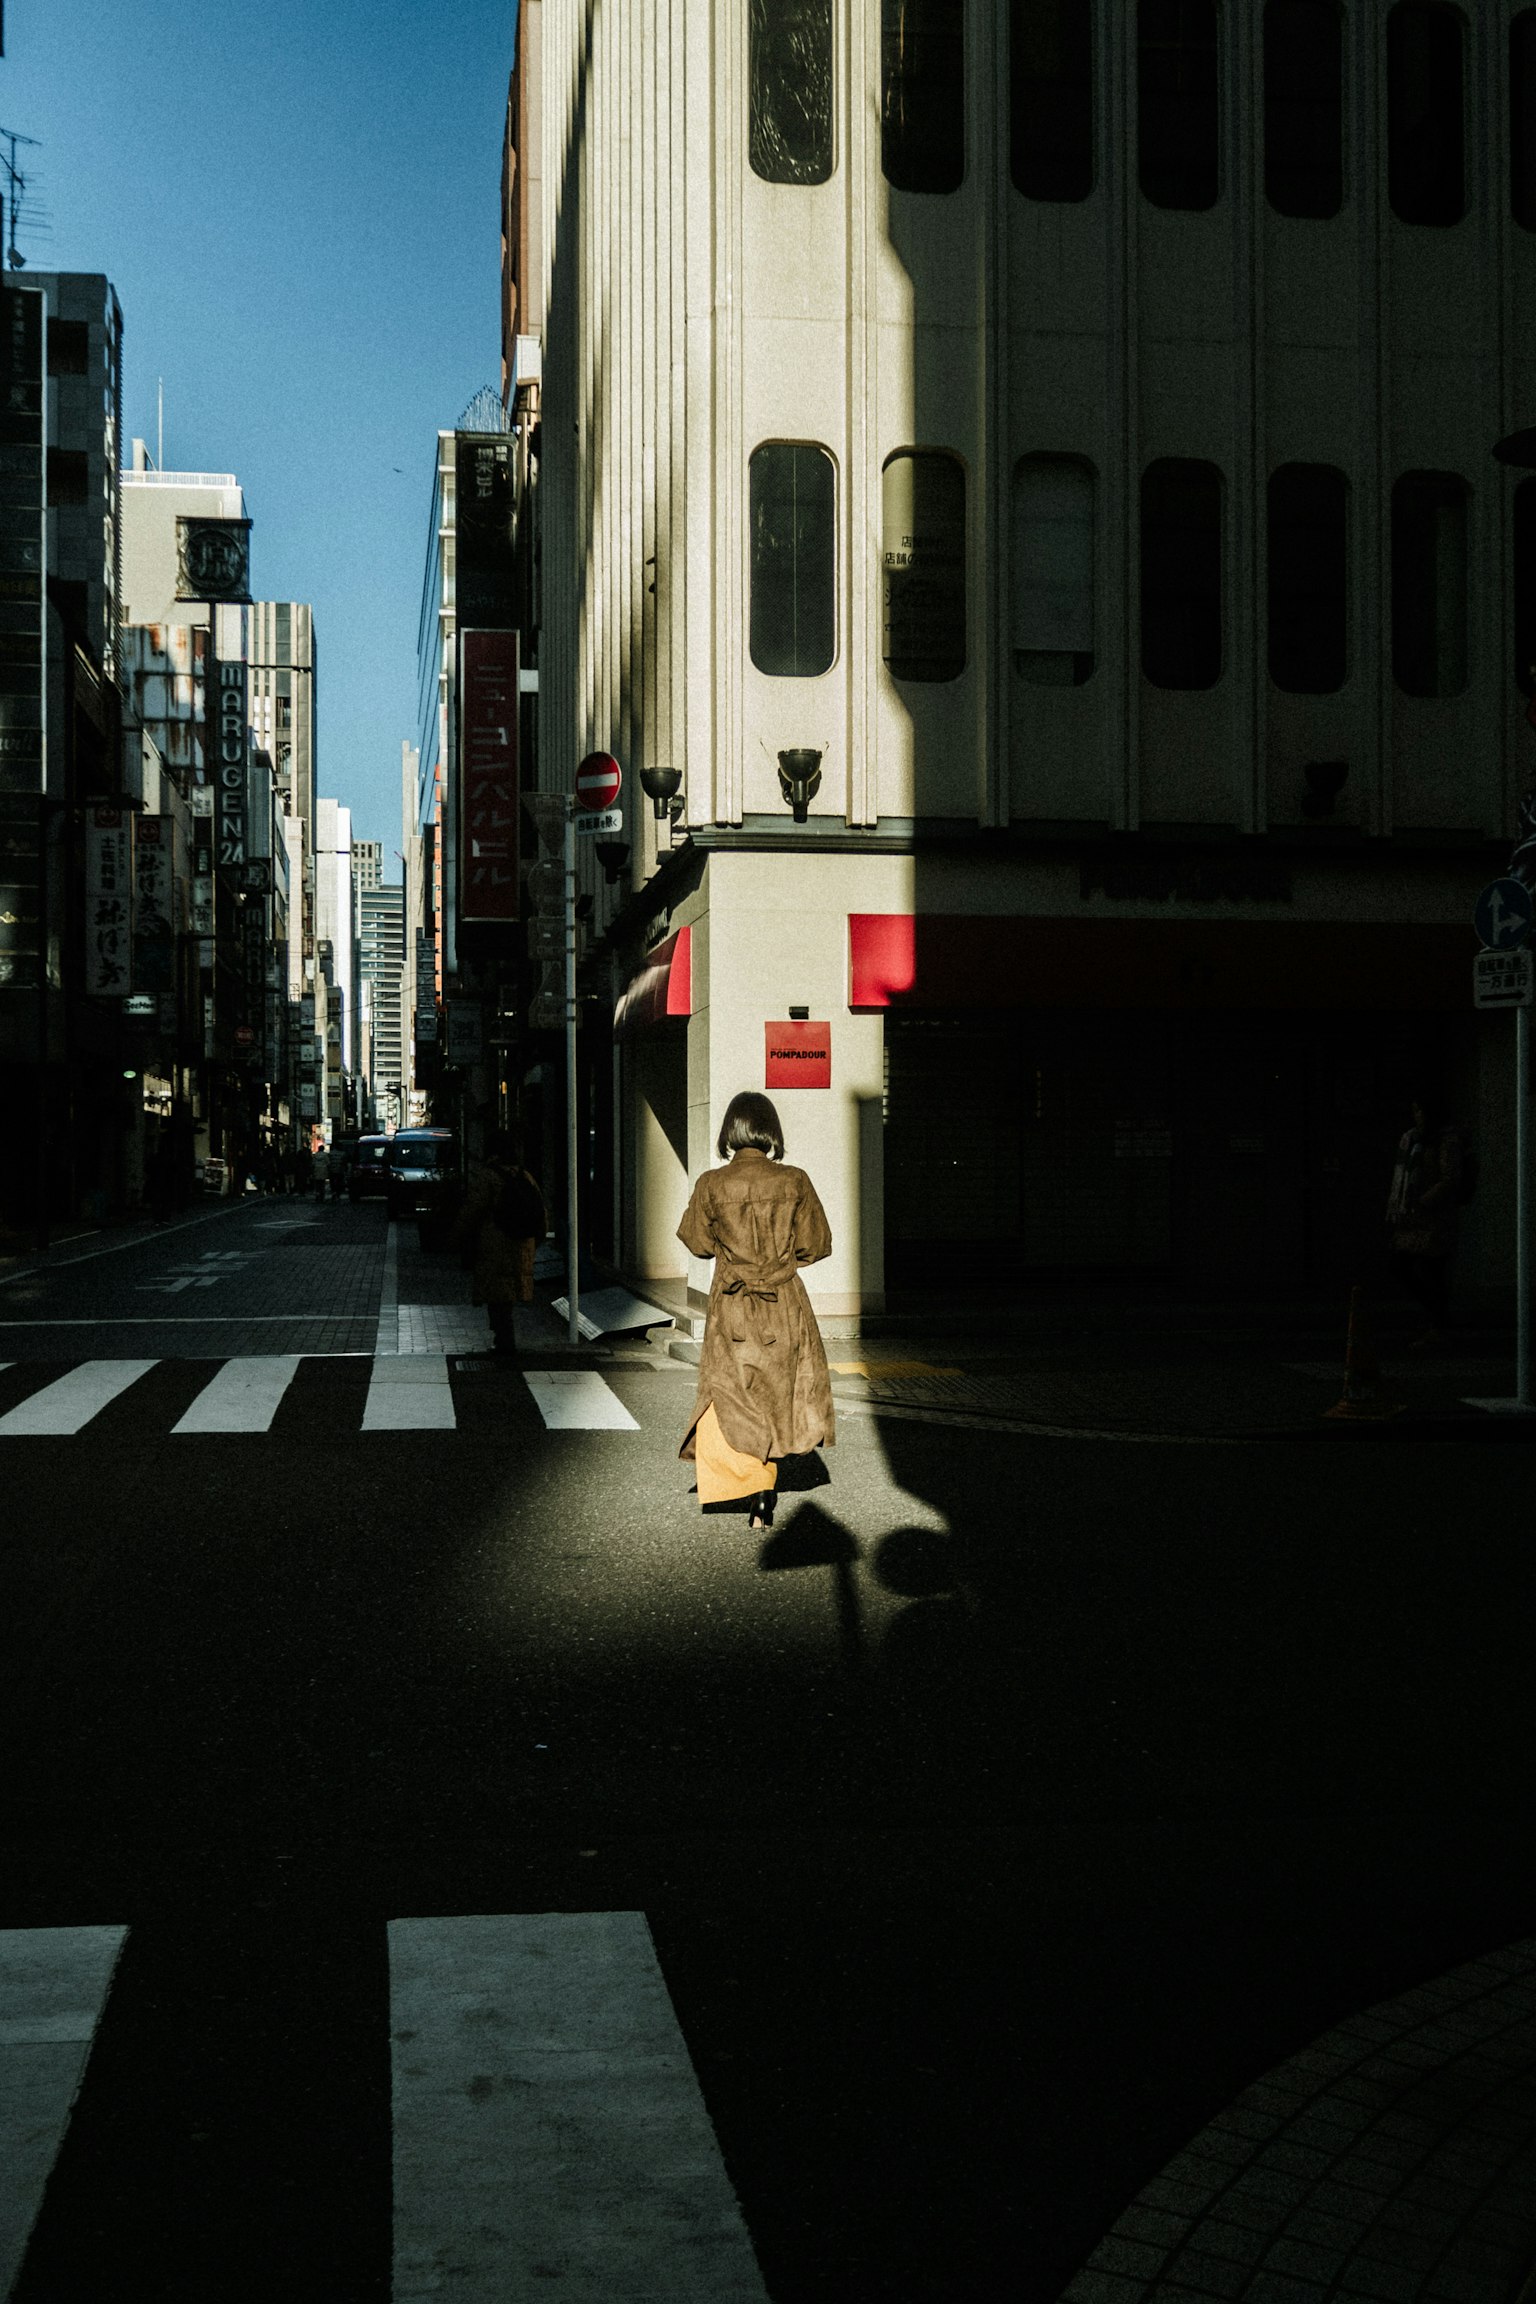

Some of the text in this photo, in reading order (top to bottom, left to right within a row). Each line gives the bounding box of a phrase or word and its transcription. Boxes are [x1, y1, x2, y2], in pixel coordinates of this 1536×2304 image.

[220, 666, 244, 865] MARUGEN 24
[1479, 974, 1528, 989] 一方通行
[770, 1050, 826, 1059] POMPADOUR
